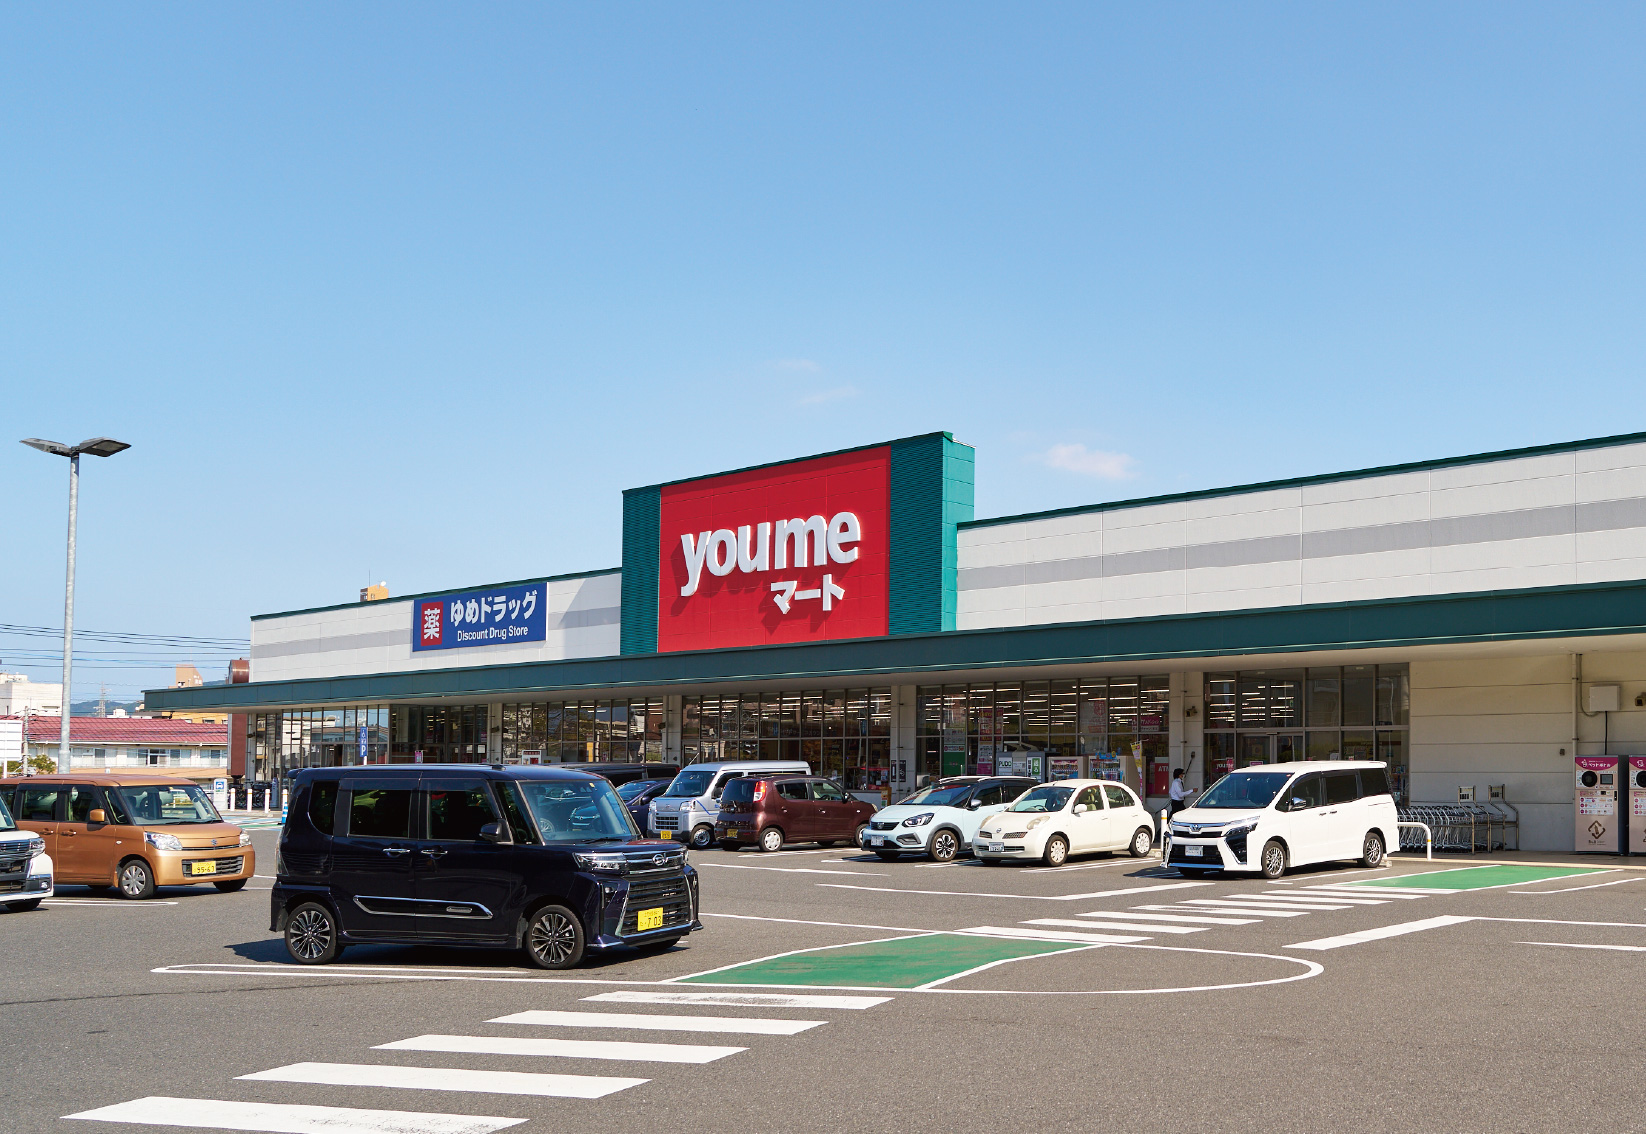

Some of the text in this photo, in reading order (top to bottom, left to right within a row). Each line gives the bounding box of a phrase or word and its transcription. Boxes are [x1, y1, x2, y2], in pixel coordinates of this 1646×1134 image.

[680, 511, 861, 597] youme
[450, 589, 538, 627] ゆめドラッグ
[770, 573, 846, 614] マート
[423, 607, 441, 640] 薬
[457, 625, 529, 642] Discount Drug Store
